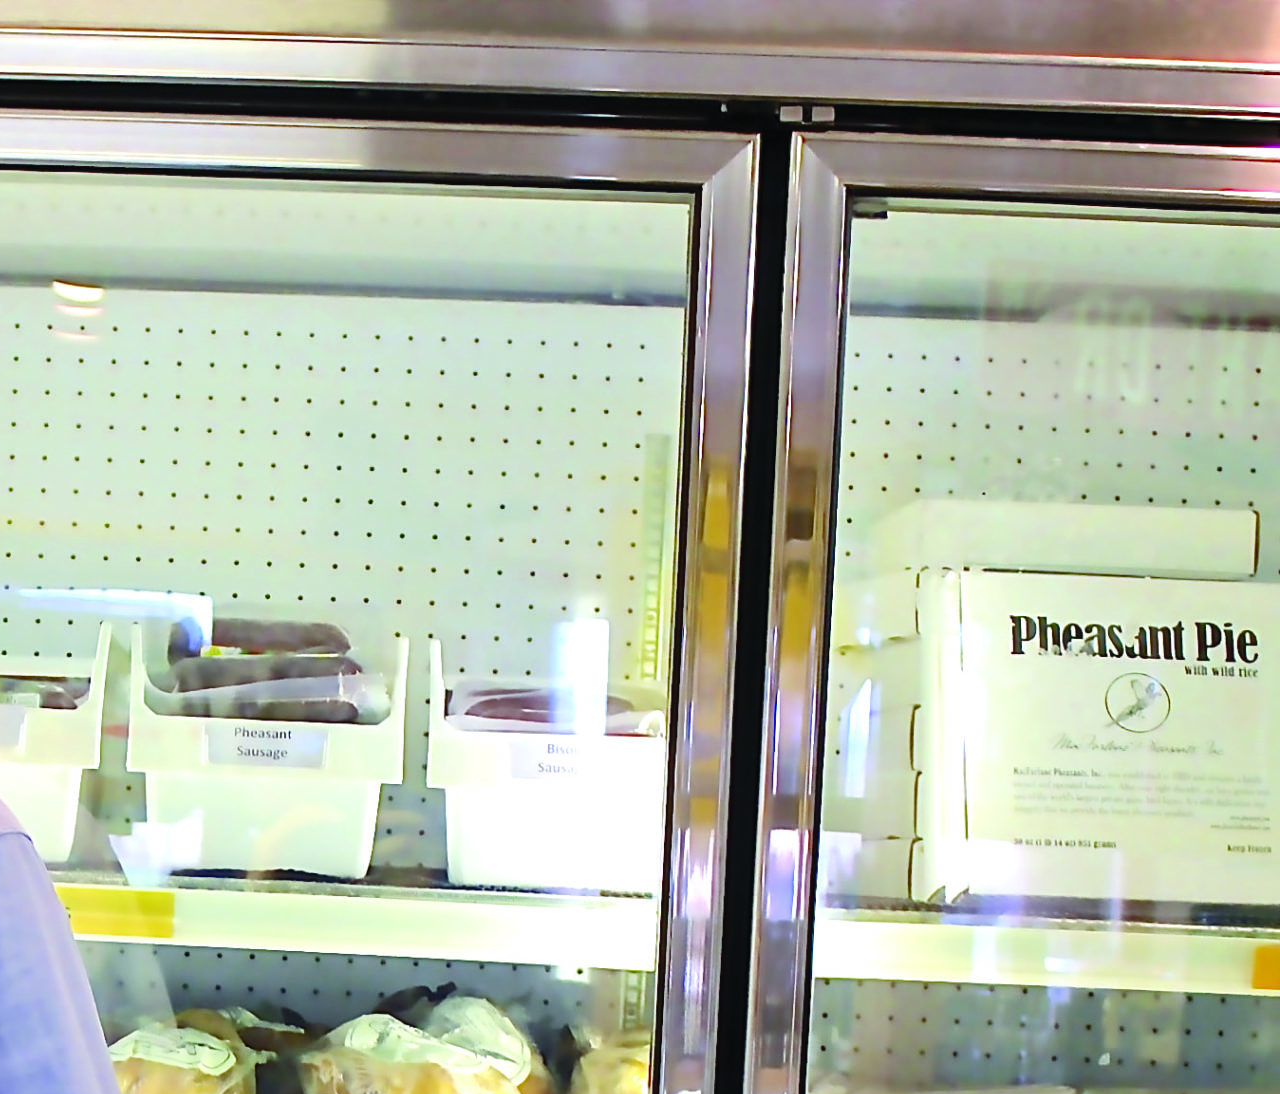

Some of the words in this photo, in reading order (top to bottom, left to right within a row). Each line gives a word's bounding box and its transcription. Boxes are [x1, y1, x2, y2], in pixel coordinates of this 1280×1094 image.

[1009, 614, 1186, 661] Pheasant
[1195, 621, 1260, 664] Pie
[1185, 664, 1208, 676] with
[1212, 666, 1235, 677] wild
[1239, 667, 1260, 678] rice
[234, 726, 293, 740] Pheasant
[236, 745, 289, 760] Sausage
